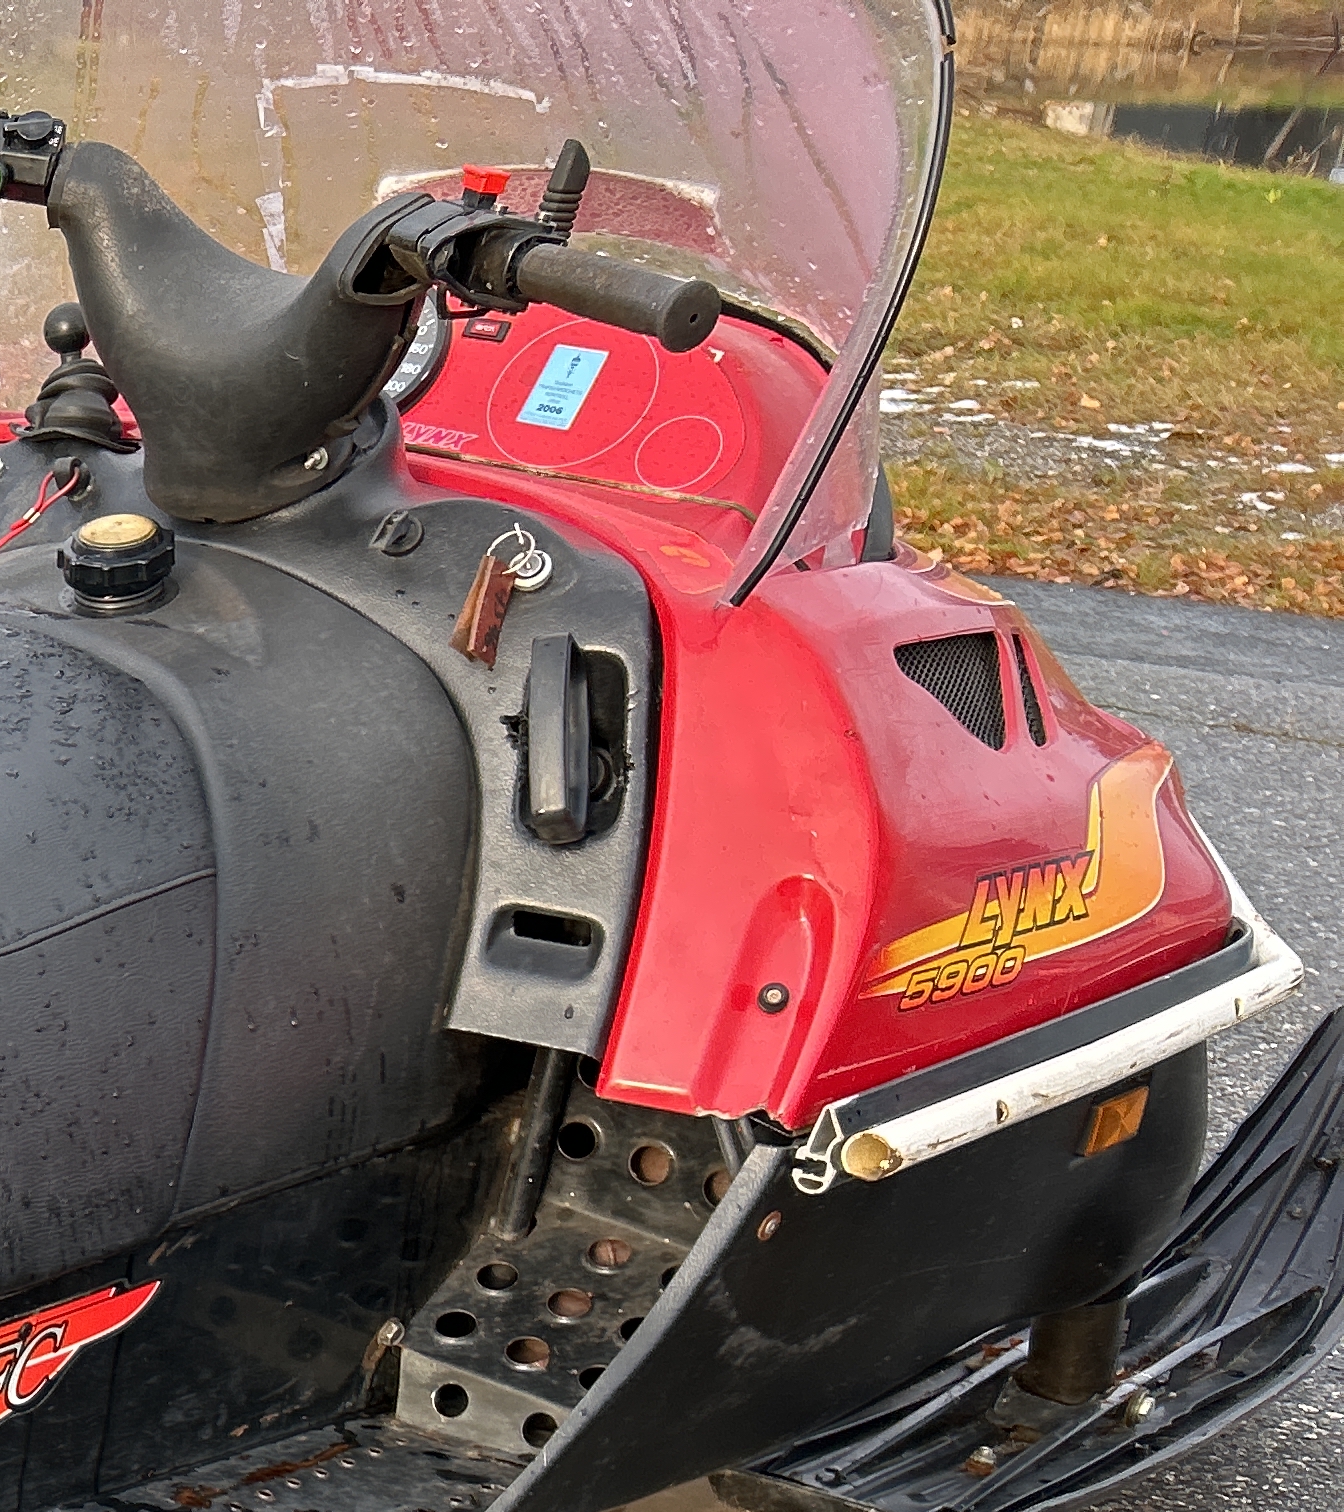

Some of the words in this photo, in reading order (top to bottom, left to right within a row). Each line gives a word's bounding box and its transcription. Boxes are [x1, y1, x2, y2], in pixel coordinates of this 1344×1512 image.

[536, 403, 563, 415] 2006
[957, 849, 1096, 951] LYNX
[898, 945, 1027, 1012] 5900
